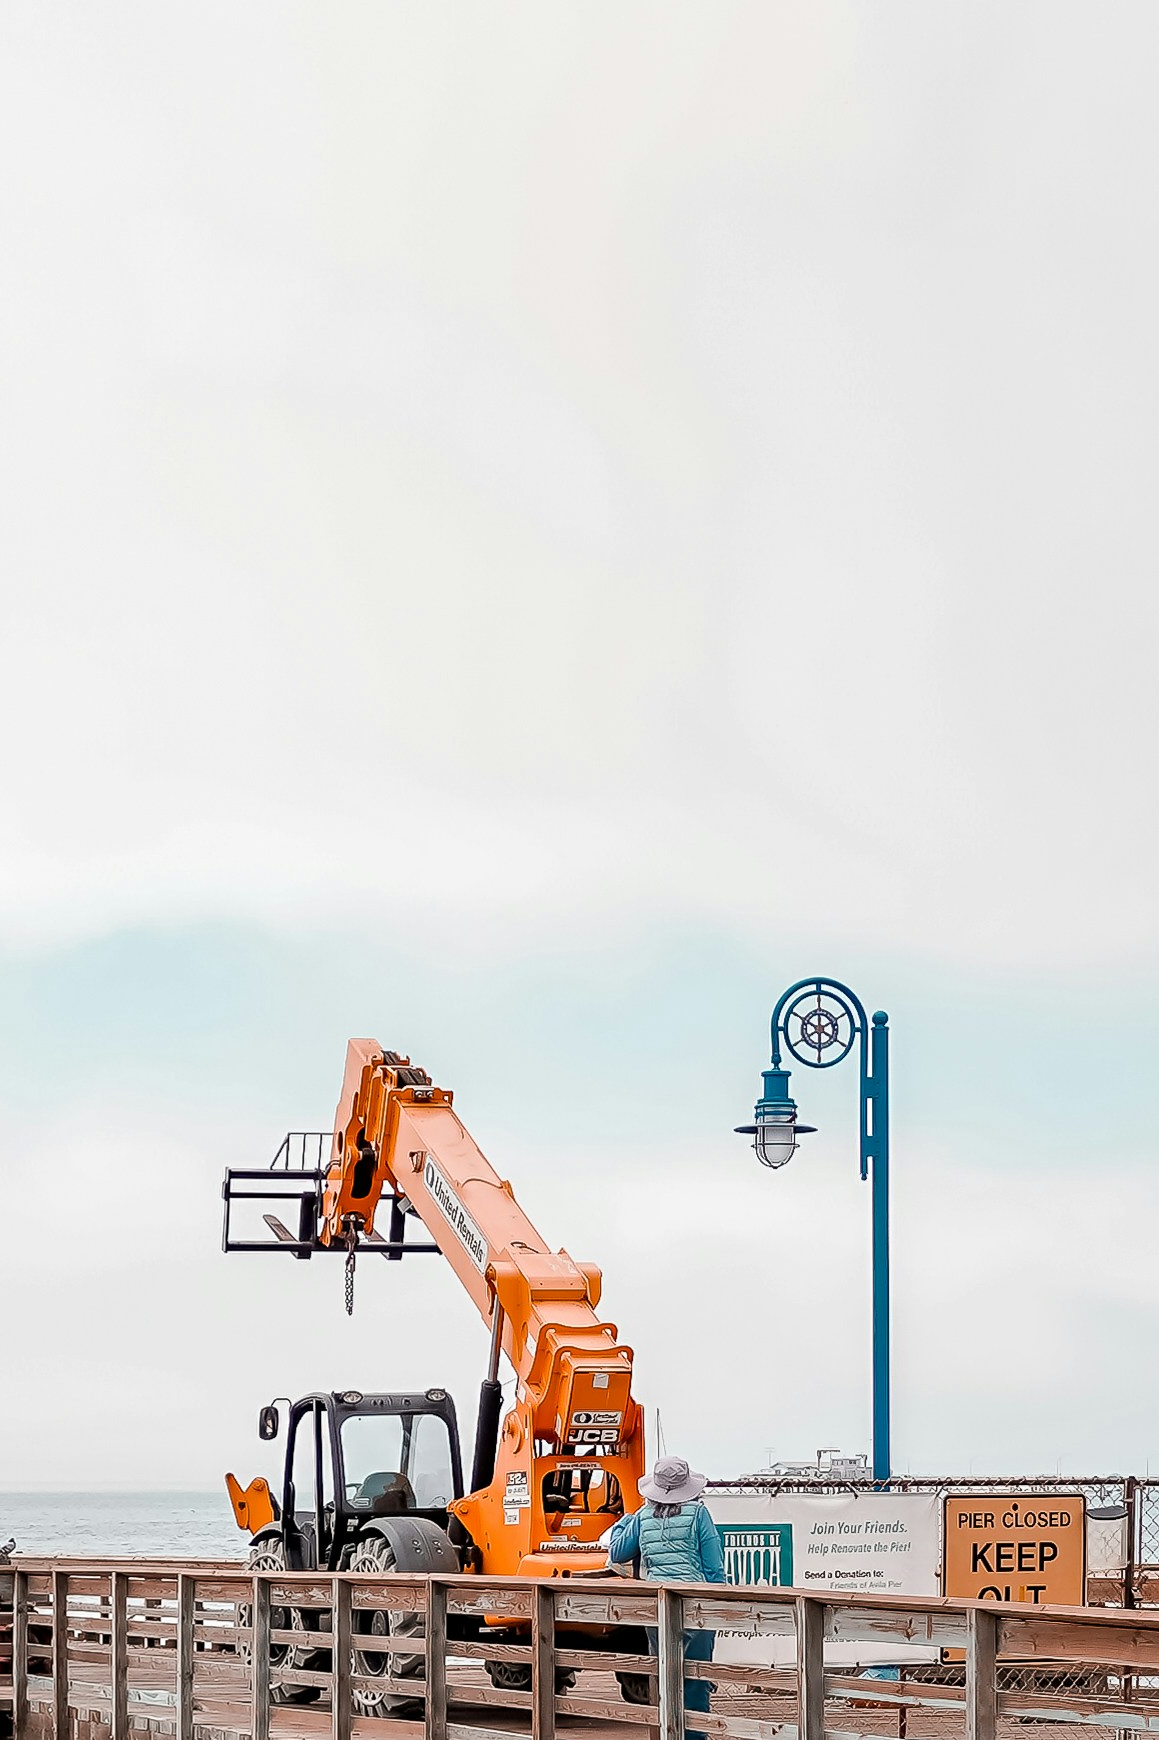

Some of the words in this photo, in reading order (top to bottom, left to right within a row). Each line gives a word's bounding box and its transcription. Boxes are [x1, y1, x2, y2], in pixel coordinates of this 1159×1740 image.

[434, 1176, 458, 1223] United
[457, 1211, 484, 1263] Rentals
[568, 1429, 618, 1442] JCB
[810, 1522, 835, 1535] Join
[838, 1521, 862, 1534] Your
[864, 1519, 908, 1534] Friends.
[958, 1512, 995, 1528] PIER
[1002, 1511, 1071, 1528] CLOSED
[724, 1534, 765, 1547] FRIENDS
[769, 1534, 781, 1546] OF
[807, 1542, 829, 1556] Help
[830, 1542, 872, 1554] Renovate
[874, 1541, 889, 1553] the
[890, 1541, 912, 1553] Pier!
[971, 1541, 1058, 1573] KEEP
[804, 1570, 826, 1579] Send
[834, 1569, 872, 1579] Donation
[873, 1569, 884, 1578] to:
[829, 1581, 858, 1589] Friends
